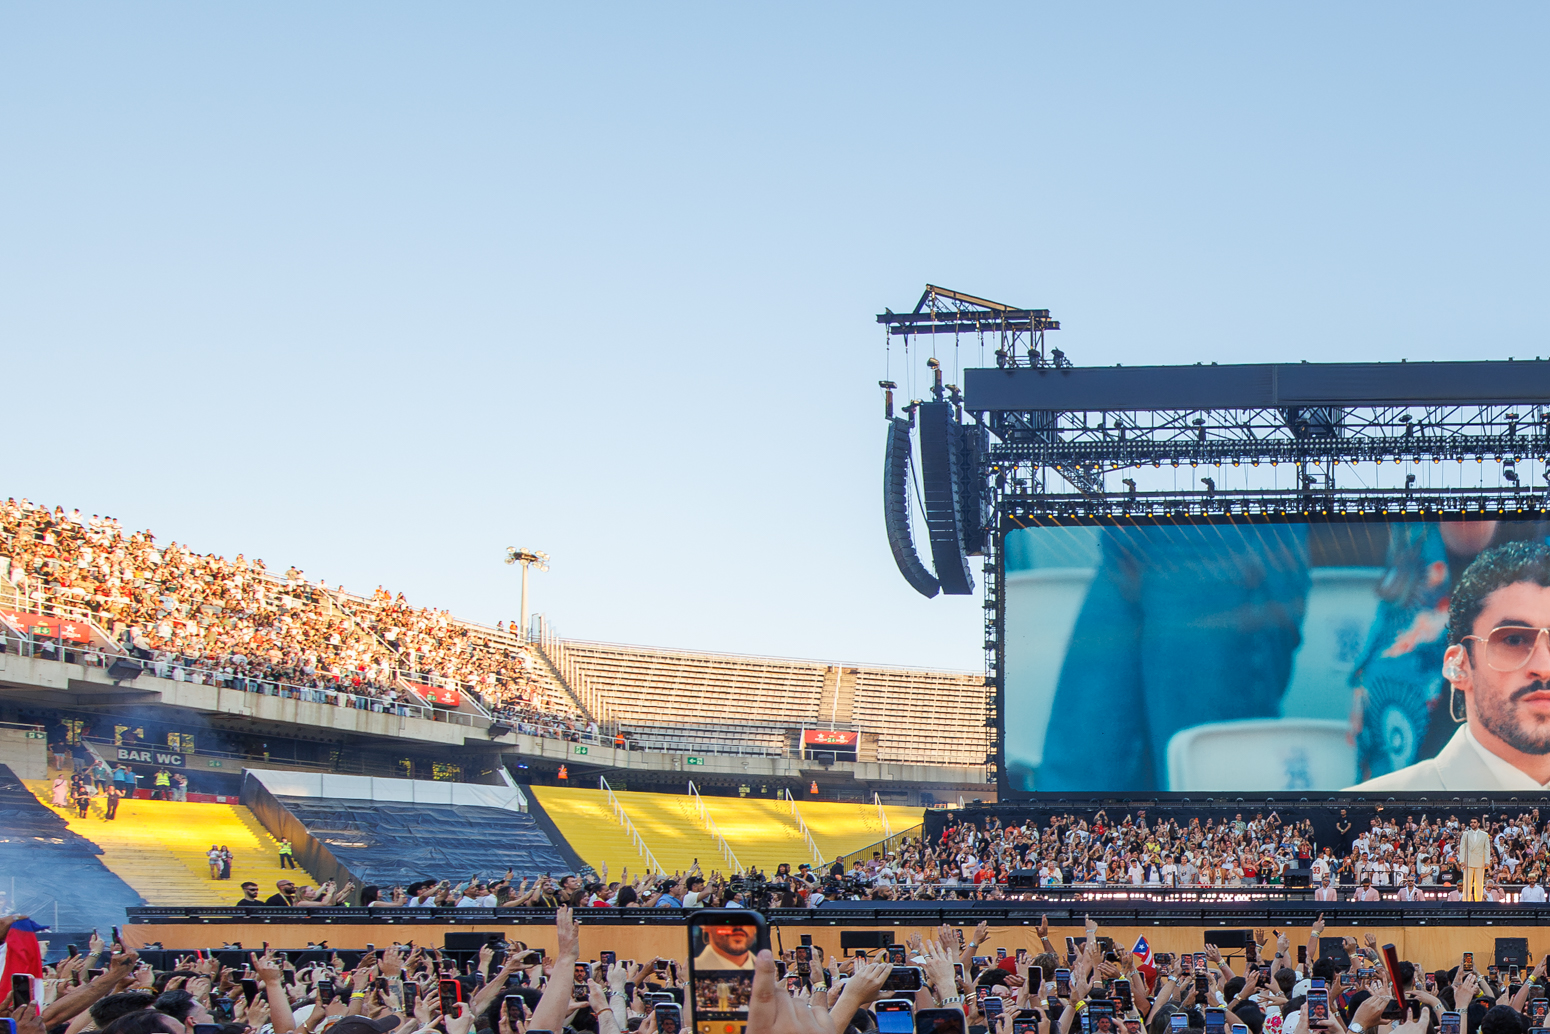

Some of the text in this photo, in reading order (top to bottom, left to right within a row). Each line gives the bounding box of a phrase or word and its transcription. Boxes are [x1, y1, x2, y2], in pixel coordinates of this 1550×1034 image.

[117, 748, 182, 766] BAR WC
[1312, 866, 1320, 874] 33
